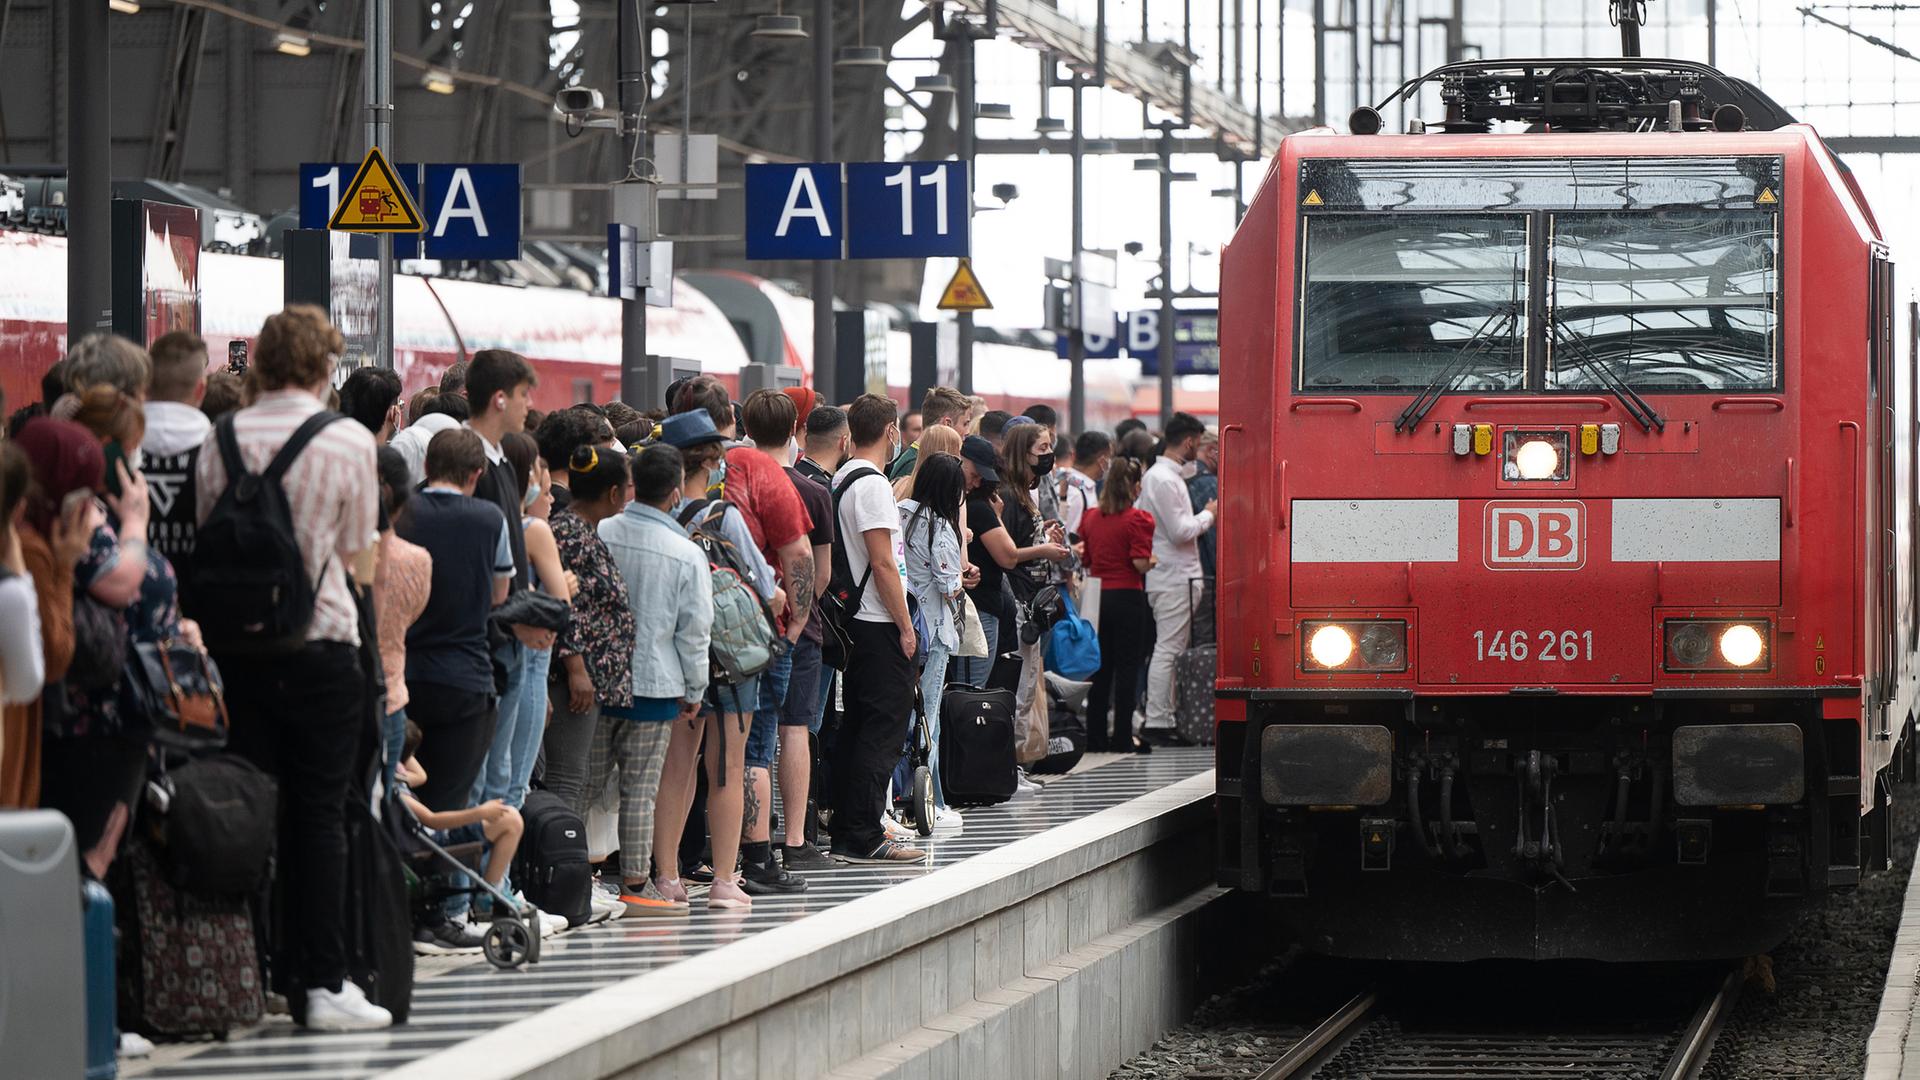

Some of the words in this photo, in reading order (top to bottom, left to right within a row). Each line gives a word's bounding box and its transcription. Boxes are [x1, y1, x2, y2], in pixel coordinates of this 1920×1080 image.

[432, 167, 489, 237] A
[774, 167, 832, 237] A
[884, 164, 948, 236] 11
[1128, 310, 1160, 351] B
[1496, 511, 1575, 559] DB
[1473, 630, 1528, 661] 146
[1538, 630, 1593, 661] 261
